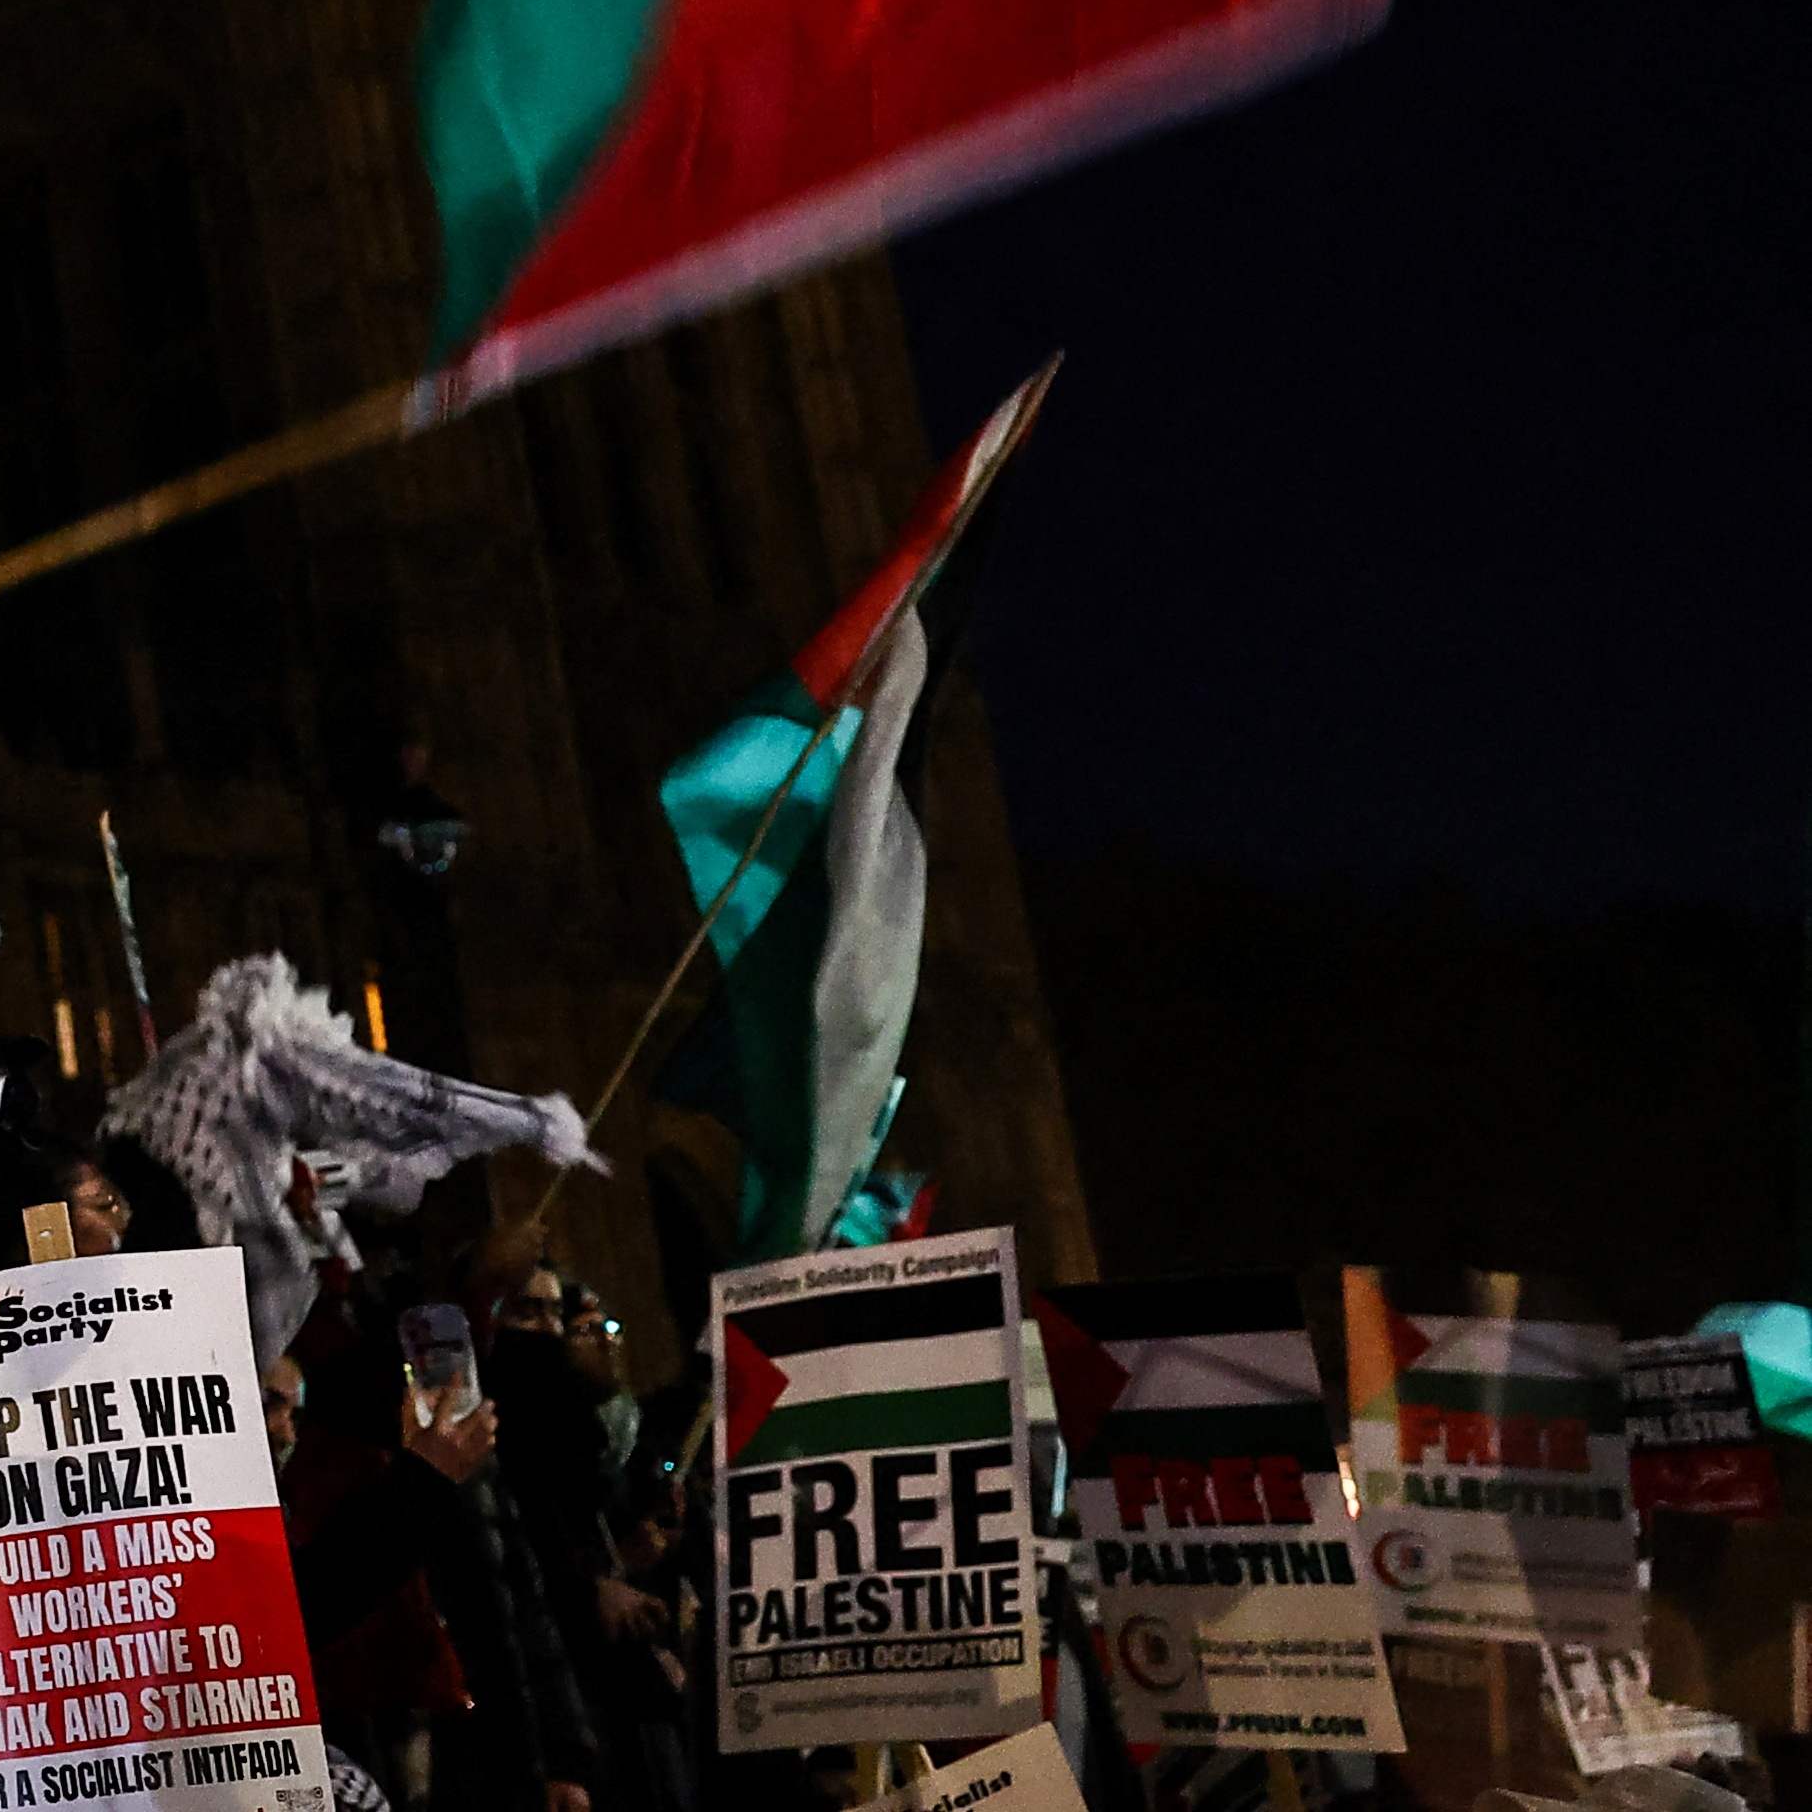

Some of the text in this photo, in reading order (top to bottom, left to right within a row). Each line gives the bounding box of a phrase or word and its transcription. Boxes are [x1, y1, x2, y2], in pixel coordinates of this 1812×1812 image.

[805, 1262, 896, 1288] Solidarity
[903, 1247, 1001, 1278] Campaign
[32, 1380, 124, 1451] THE
[129, 1374, 237, 1438] WAR
[1398, 1403, 1592, 1474] FREE
[55, 1444, 193, 1517] GAZA!
[1111, 1454, 1316, 1531] FREE
[82, 1529, 107, 1574] A
[113, 1516, 216, 1570] MASS
[727, 1443, 1021, 1589] FREE
[1094, 1540, 1357, 1586] PALESTINE
[8, 1572, 184, 1639] WORKERS'
[727, 1566, 1024, 1648] PALESTINE
[198, 1623, 243, 1670] TO
[778, 1648, 866, 1679] ISRAELI
[872, 1637, 1020, 1672] OCCUPATION
[63, 1690, 130, 1745] AND
[139, 1674, 301, 1735] STARMER
[16, 1771, 42, 1807] A
[42, 1751, 175, 1802] SOCIALIST
[182, 1739, 301, 1786] INTIFADA
